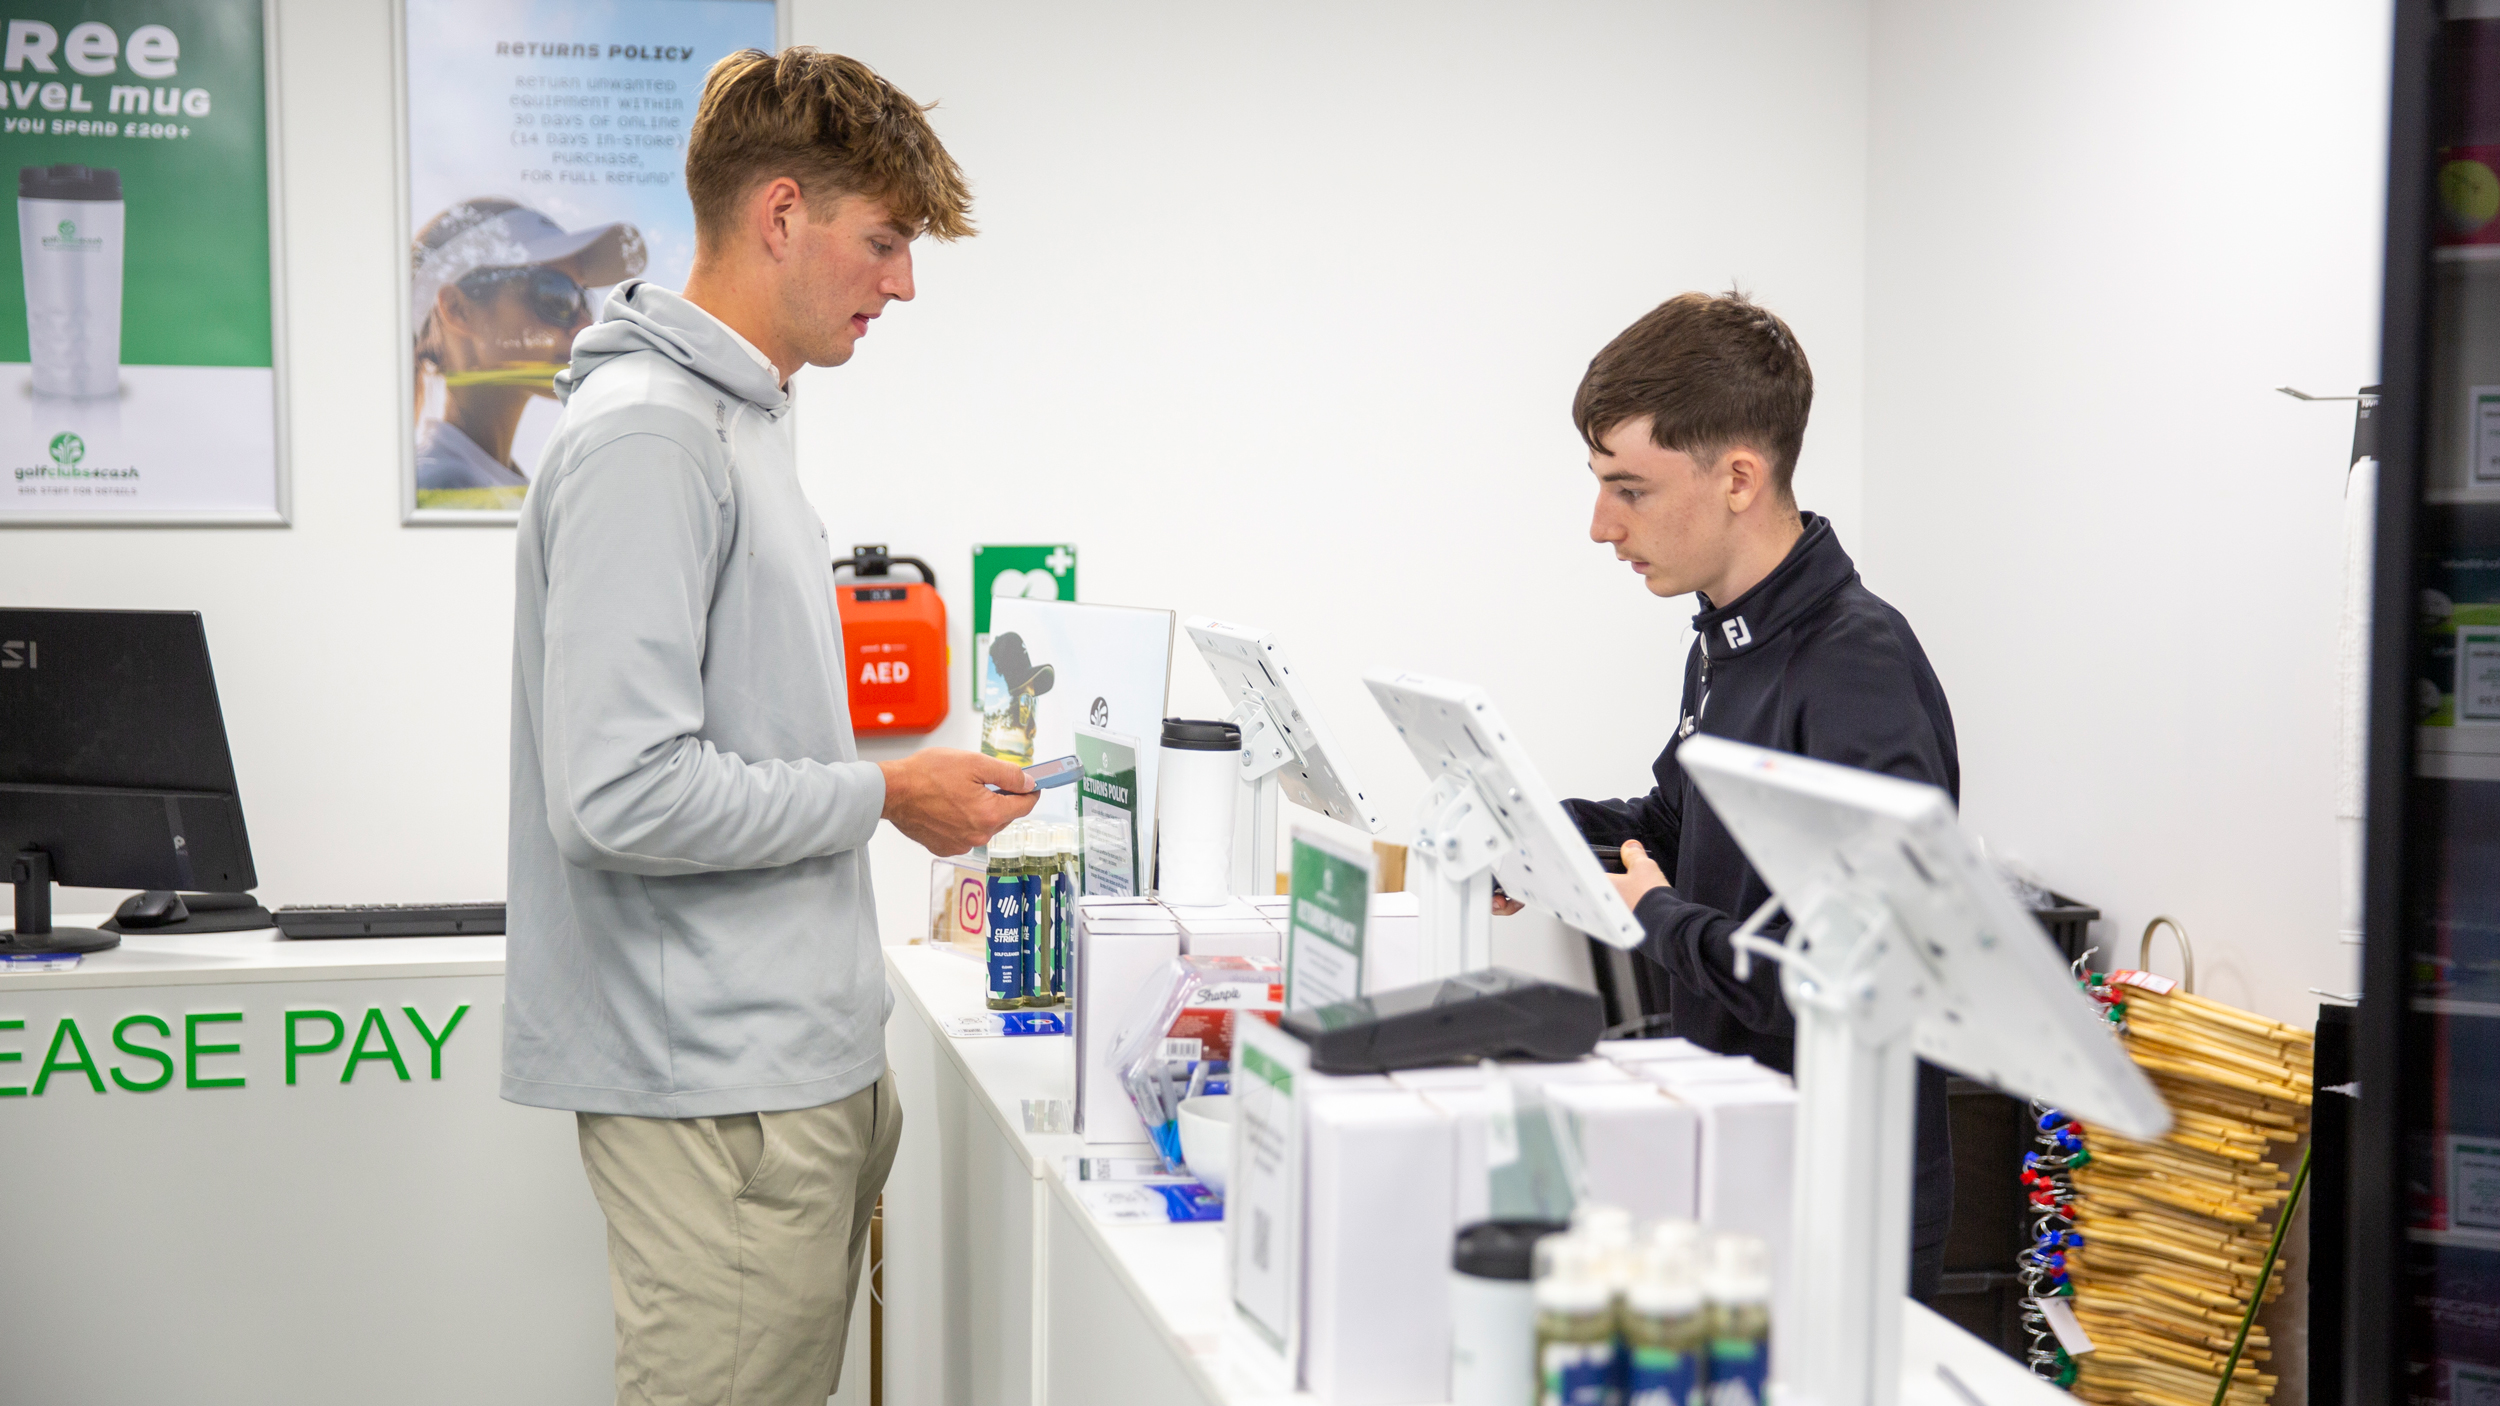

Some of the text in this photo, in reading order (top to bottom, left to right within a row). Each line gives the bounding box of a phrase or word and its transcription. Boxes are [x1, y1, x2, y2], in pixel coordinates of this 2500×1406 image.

[1721, 615, 1751, 649] FJ
[860, 661, 910, 684] AED
[1082, 776, 1129, 804] RETURNS POLICY
[994, 935, 1019, 943] STRIKE
[995, 928, 1018, 936] CLEAN
[1194, 987, 1241, 1005] Sharpie
[284, 1005, 471, 1087] PAY
